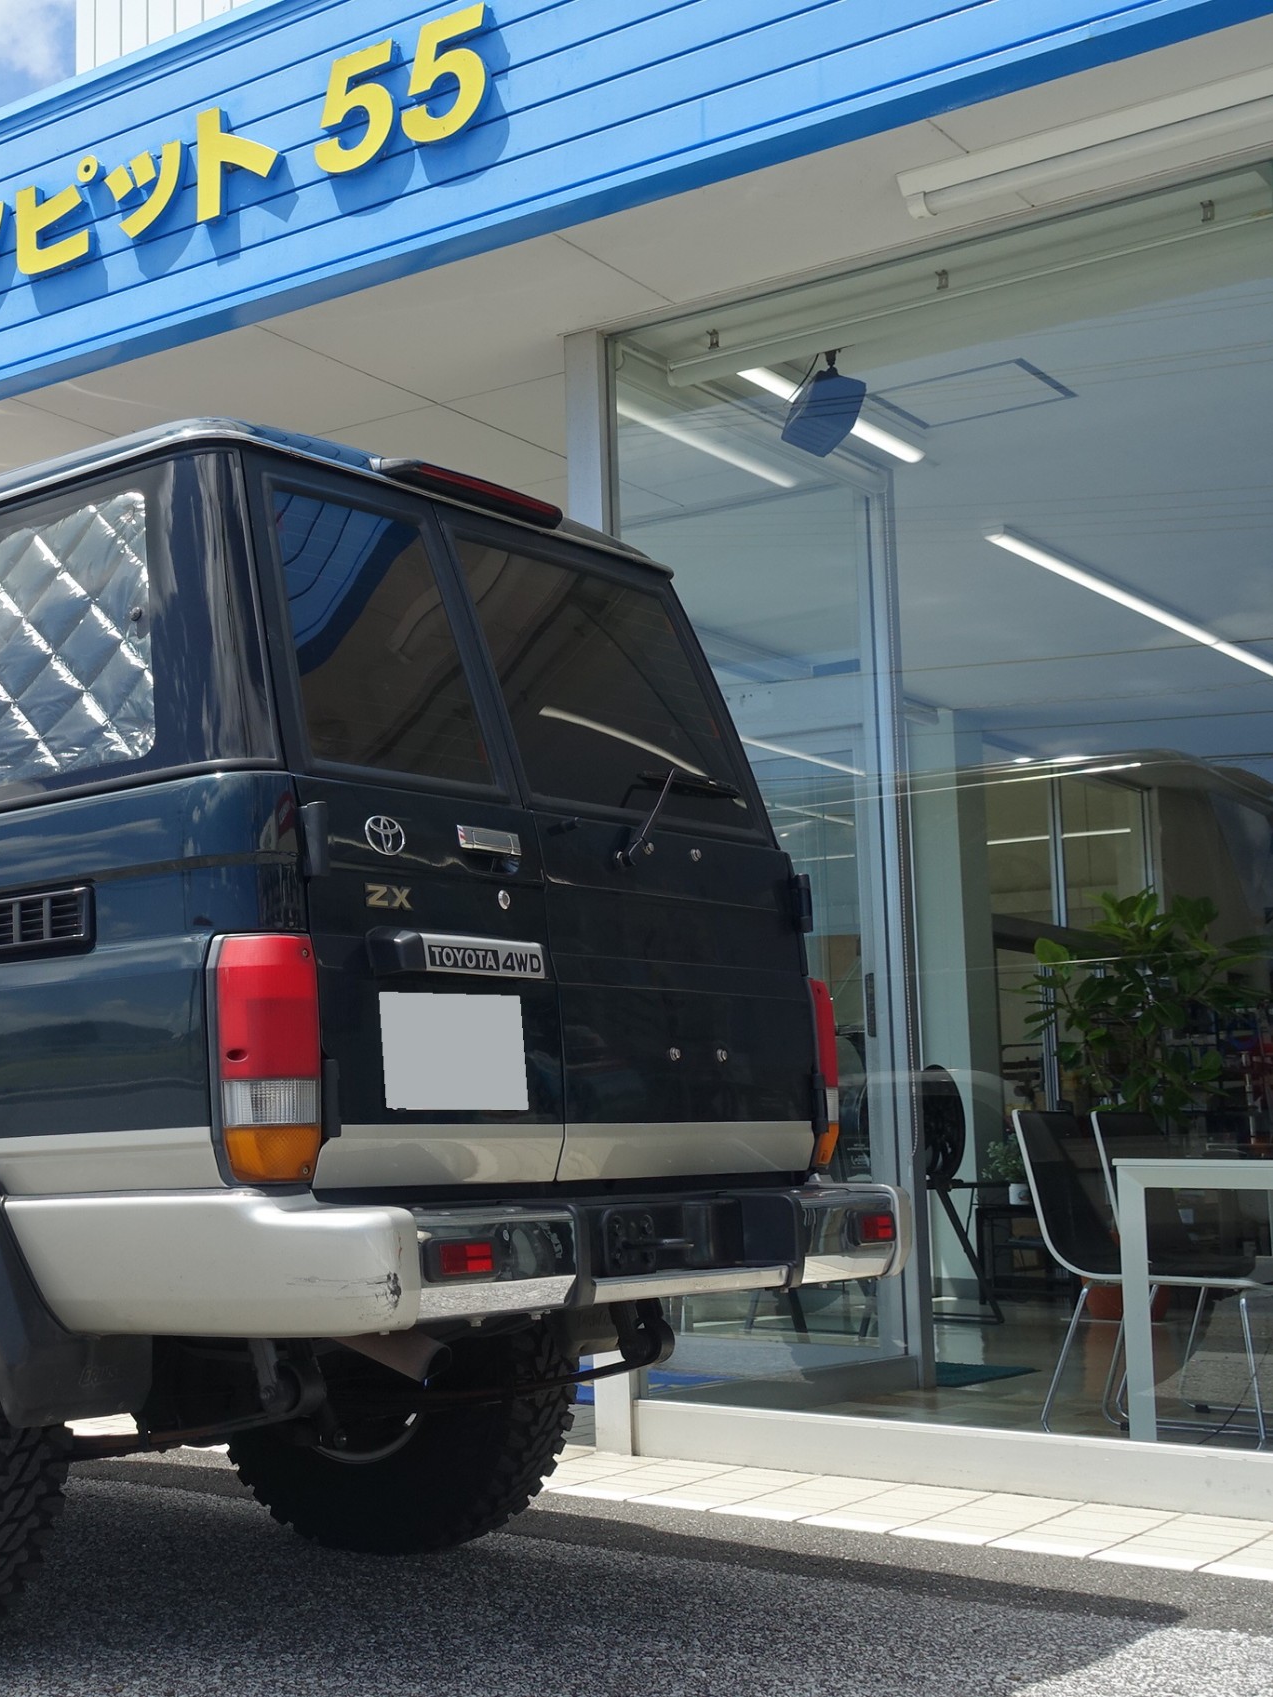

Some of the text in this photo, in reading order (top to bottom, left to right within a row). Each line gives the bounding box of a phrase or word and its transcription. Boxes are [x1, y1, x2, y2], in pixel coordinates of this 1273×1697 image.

[314, 3, 492, 175] 55
[365, 884, 413, 911] ZX
[430, 946, 541, 973] TOYOTA 4WD
